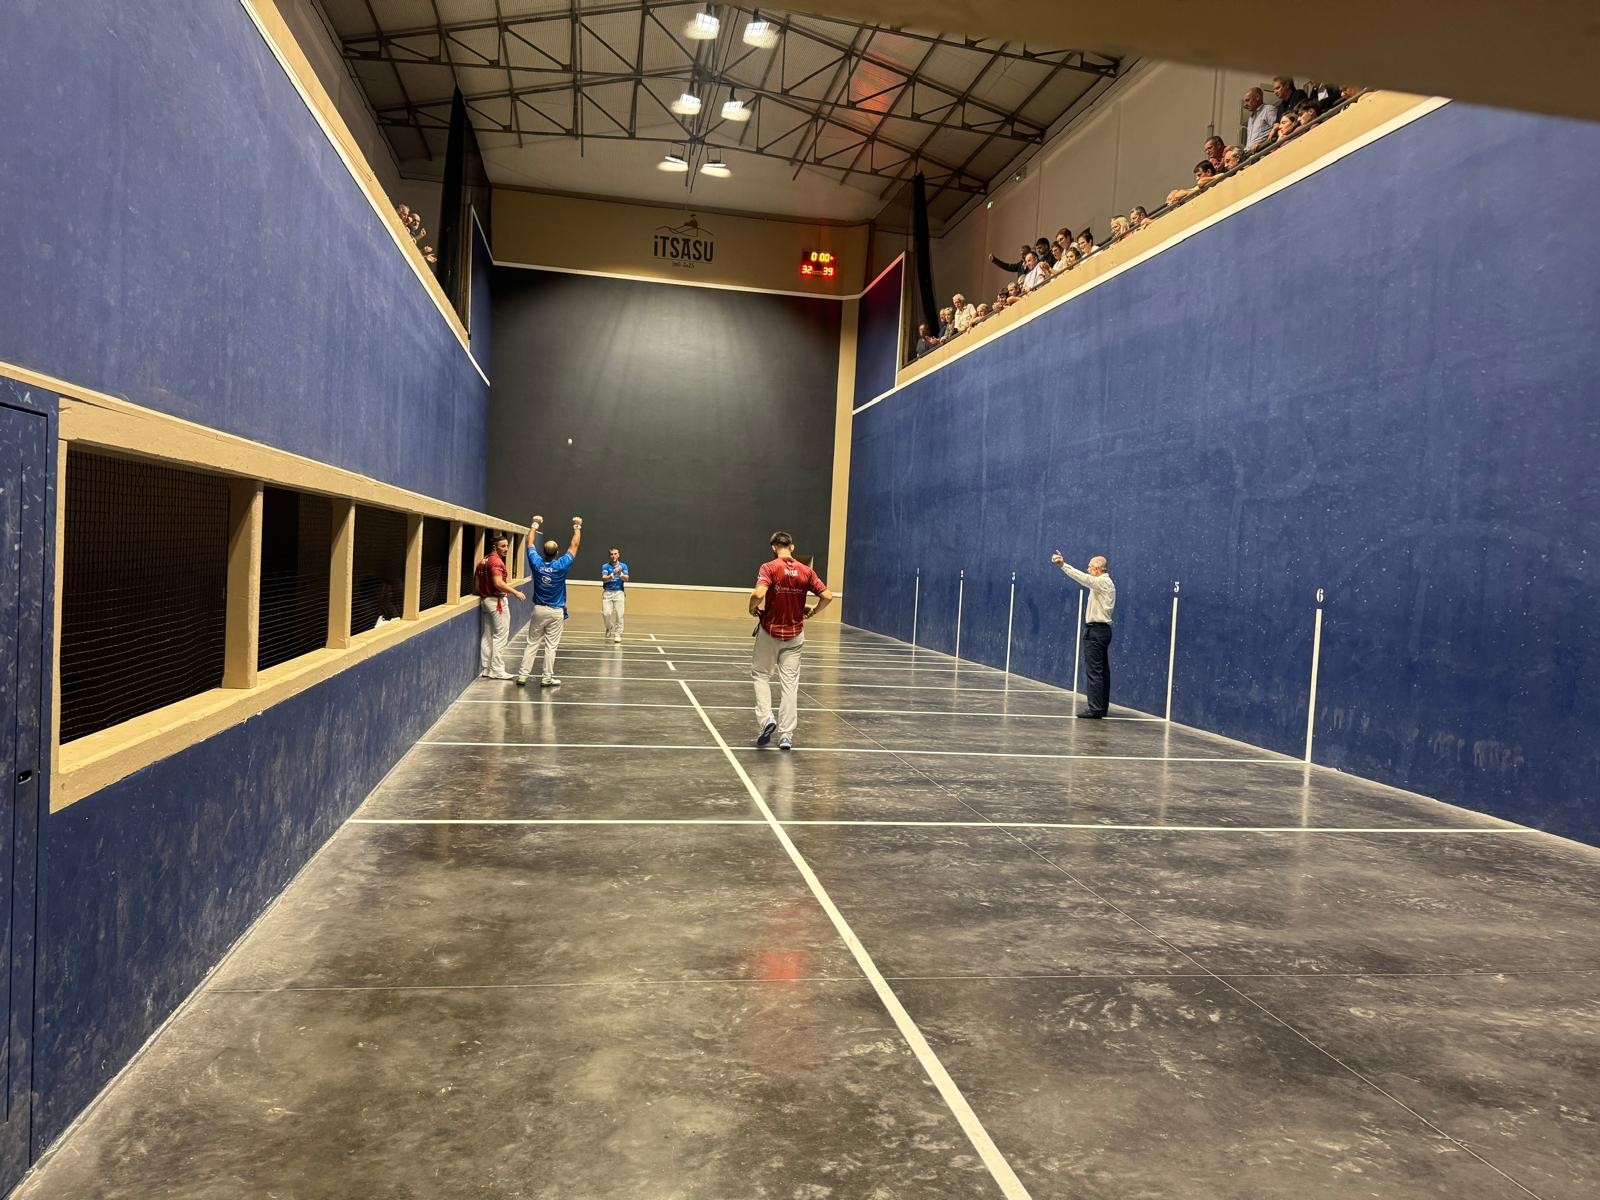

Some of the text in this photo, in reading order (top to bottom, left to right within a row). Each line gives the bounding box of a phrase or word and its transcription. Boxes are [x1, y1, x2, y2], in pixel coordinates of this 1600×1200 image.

[802, 265, 813, 274] 32
[823, 267, 833, 276] 39
[1173, 581, 1180, 593] 5
[1316, 588, 1324, 603] 6
